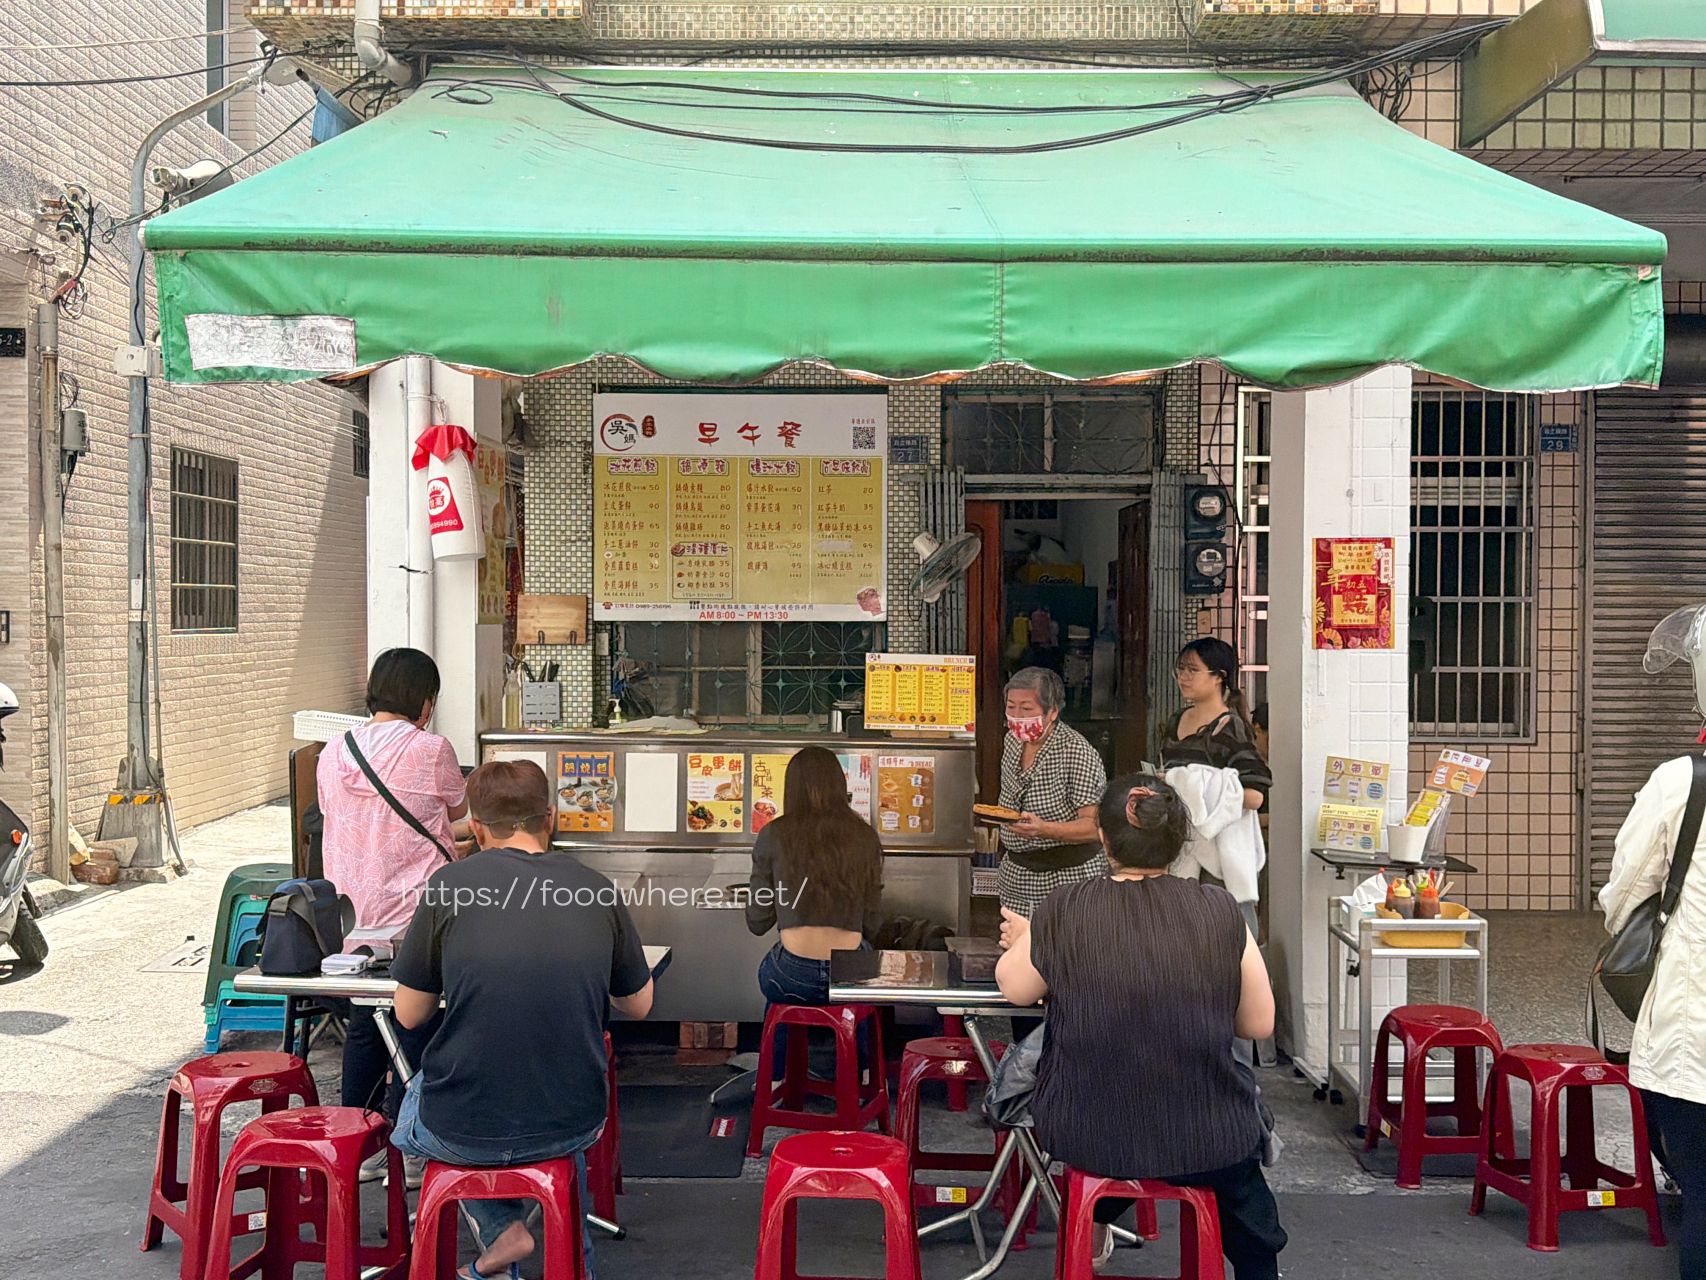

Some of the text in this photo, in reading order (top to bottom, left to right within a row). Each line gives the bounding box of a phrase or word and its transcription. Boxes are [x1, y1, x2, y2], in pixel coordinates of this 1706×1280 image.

[608, 420, 636, 444] 吳媽
[698, 421, 802, 448] 早午餐
[1547, 440, 1564, 450] 29
[897, 451, 913, 461] 27
[699, 611, 715, 619] AM
[716, 611, 736, 619] 8:00
[747, 611, 762, 619] PM
[764, 611, 789, 619] 13:30
